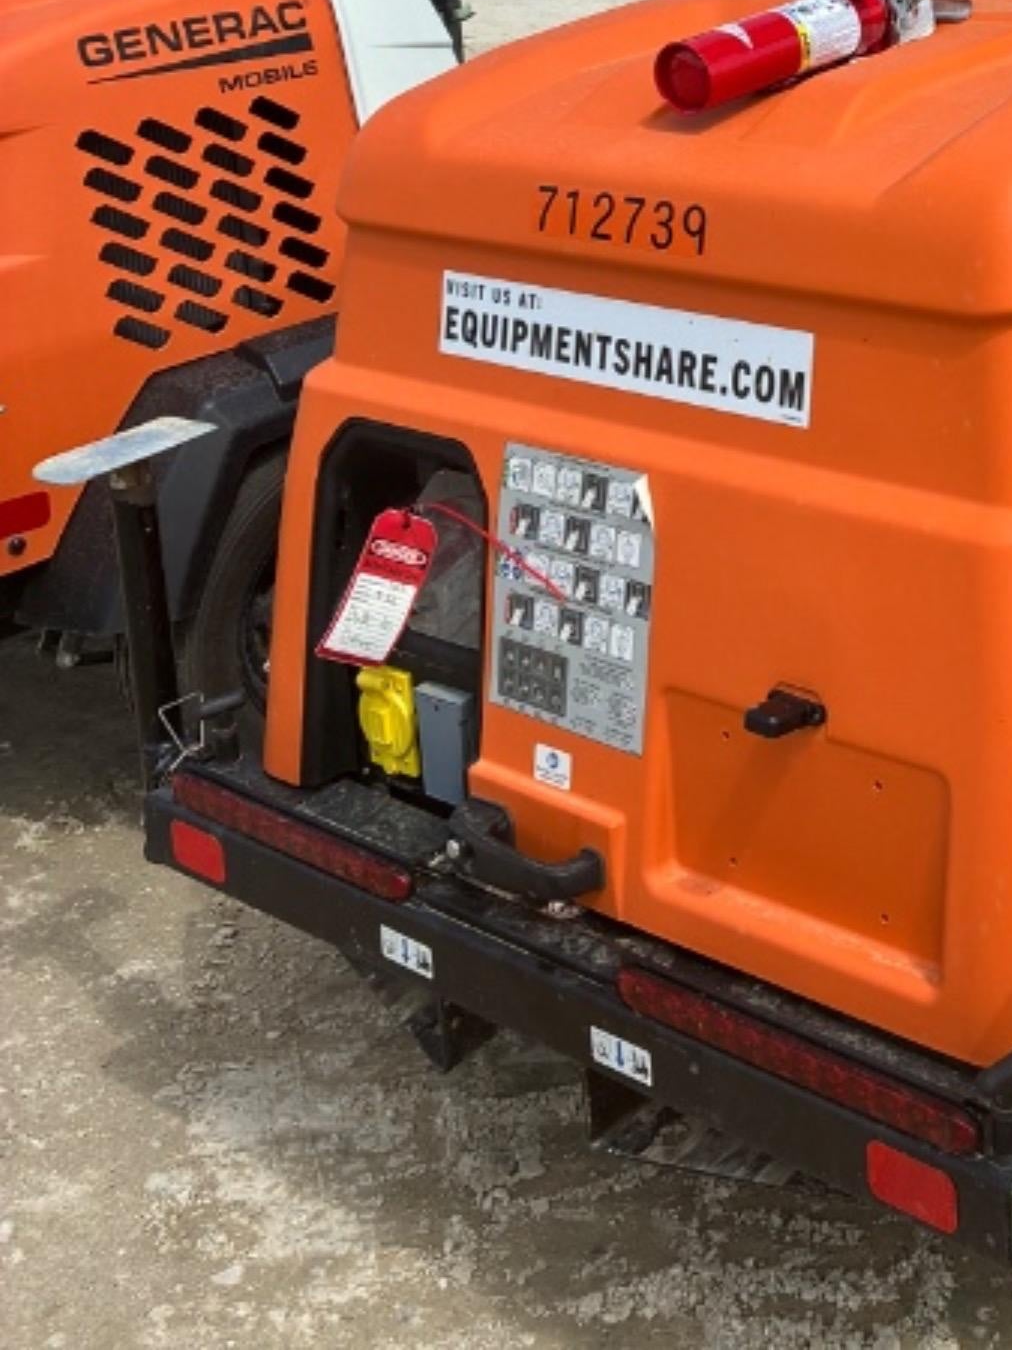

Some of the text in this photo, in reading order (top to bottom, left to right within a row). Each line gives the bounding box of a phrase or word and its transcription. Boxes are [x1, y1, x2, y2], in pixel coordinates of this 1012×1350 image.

[77, 0, 307, 67] GENERAC
[218, 60, 318, 93] MOBILE
[538, 185, 707, 256] 712739
[446, 278, 542, 310] VISIT US AT:
[444, 305, 806, 412] EQUIPMENTSHARE.COM
